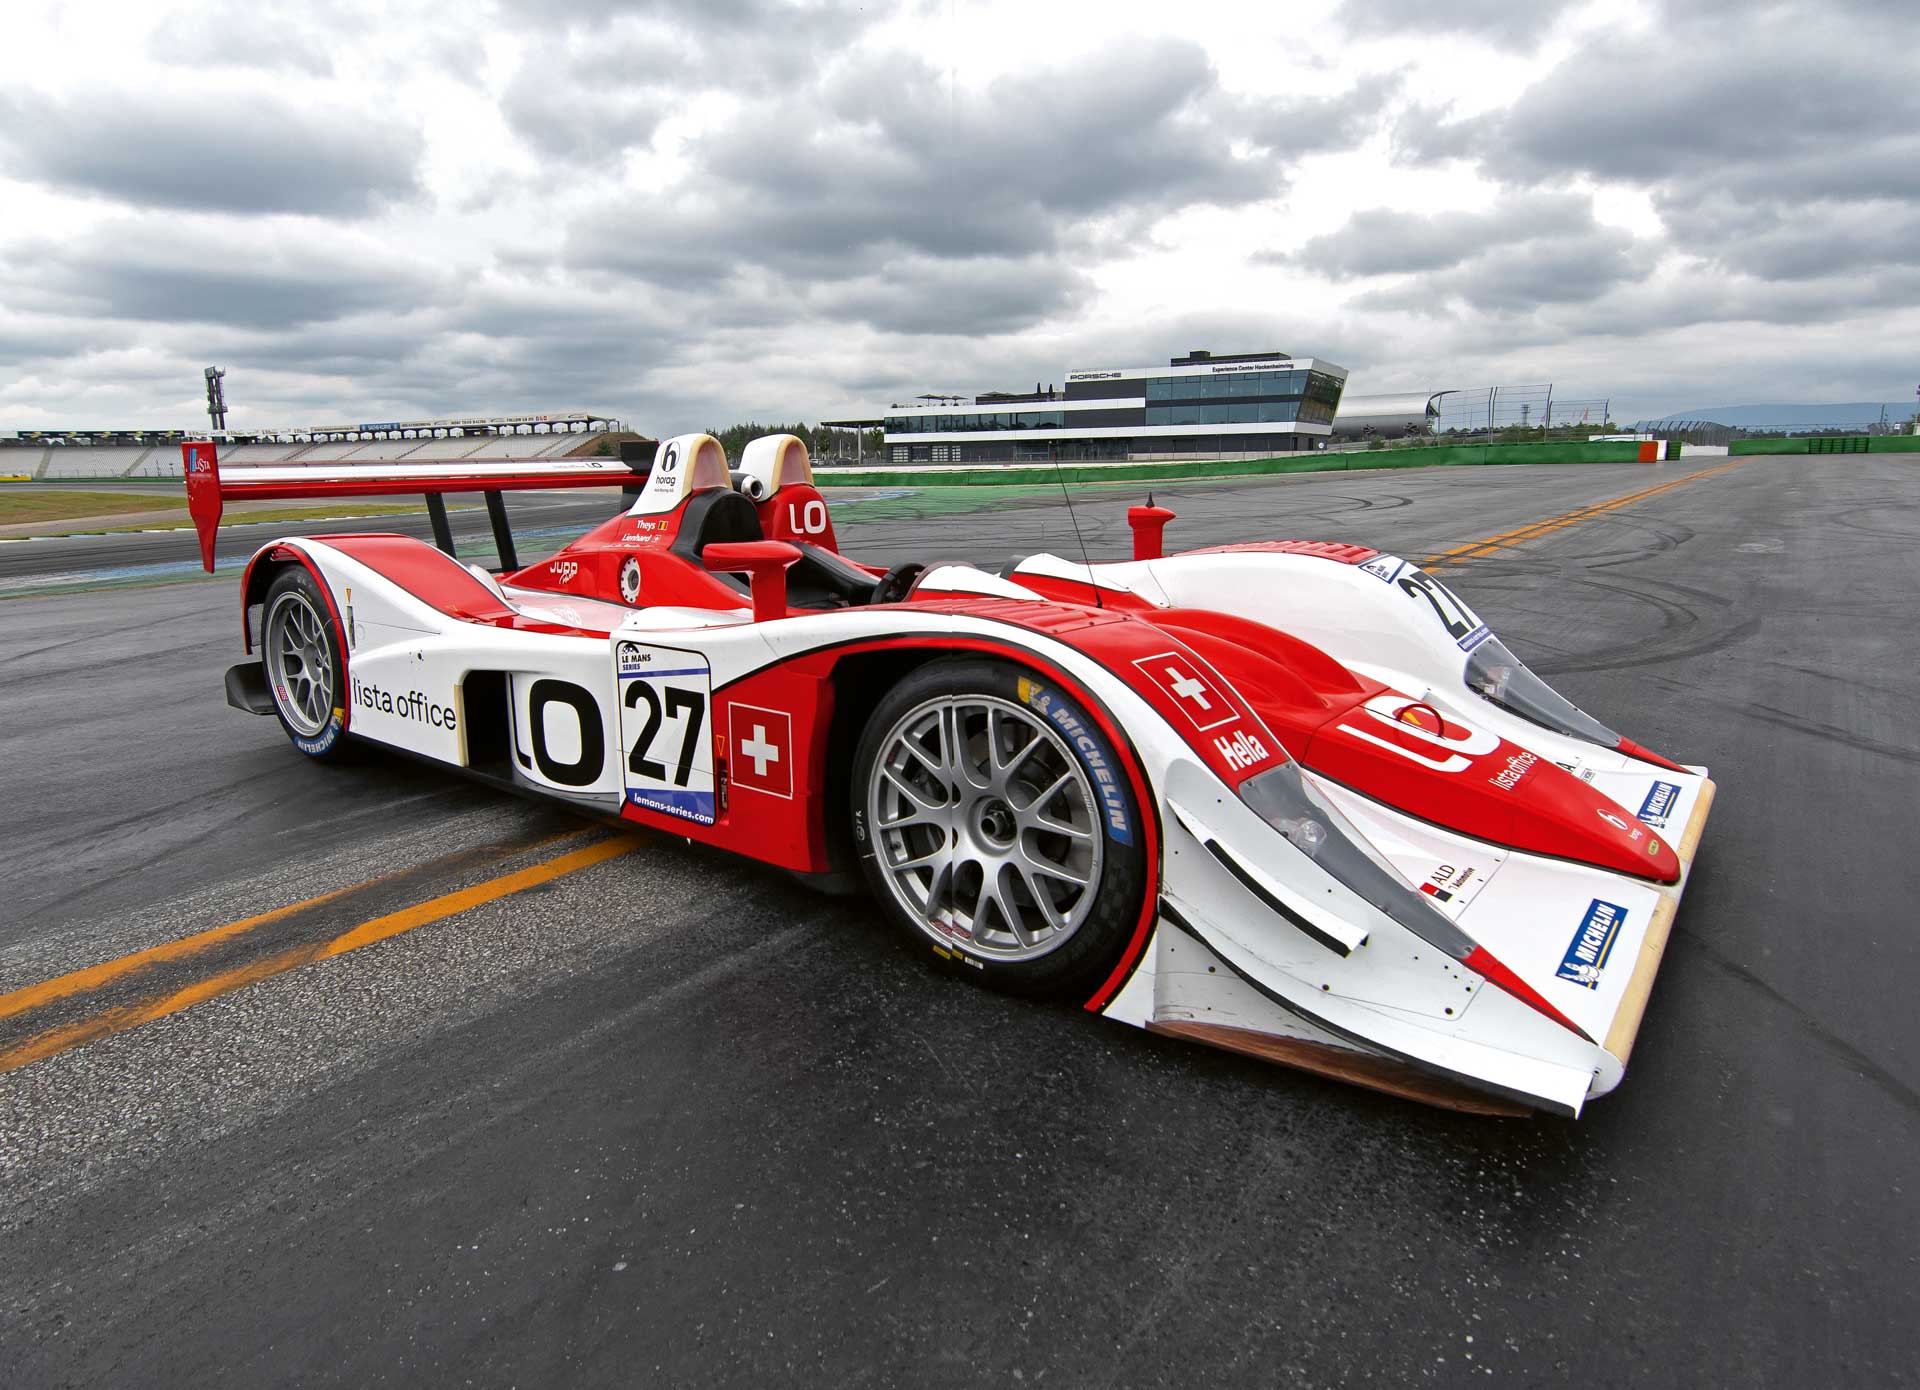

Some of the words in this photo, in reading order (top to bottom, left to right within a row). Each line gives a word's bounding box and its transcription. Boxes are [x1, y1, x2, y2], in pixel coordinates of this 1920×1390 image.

[1070, 372, 1122, 380] PORSCHE
[656, 475, 676, 487] horag
[637, 519, 656, 531] Theys
[788, 500, 827, 534] LO
[621, 533, 653, 542] Lienhard
[550, 561, 578, 575] JUDD
[621, 653, 630, 663] LE
[631, 652, 651, 664] MANS
[622, 663, 641, 671] SERIES
[298, 729, 335, 754] MICHELIN
[509, 672, 605, 787] LO
[624, 679, 705, 788] 27
[1336, 695, 1501, 773] LO
[1213, 729, 1270, 772] Hella
[1052, 706, 1127, 832] MICHELIN
[634, 792, 714, 825] lemans-series.com
[1647, 782, 1674, 817] MICHELIN
[1431, 864, 1456, 885] ALD
[1575, 903, 1617, 963] MICHELIN
